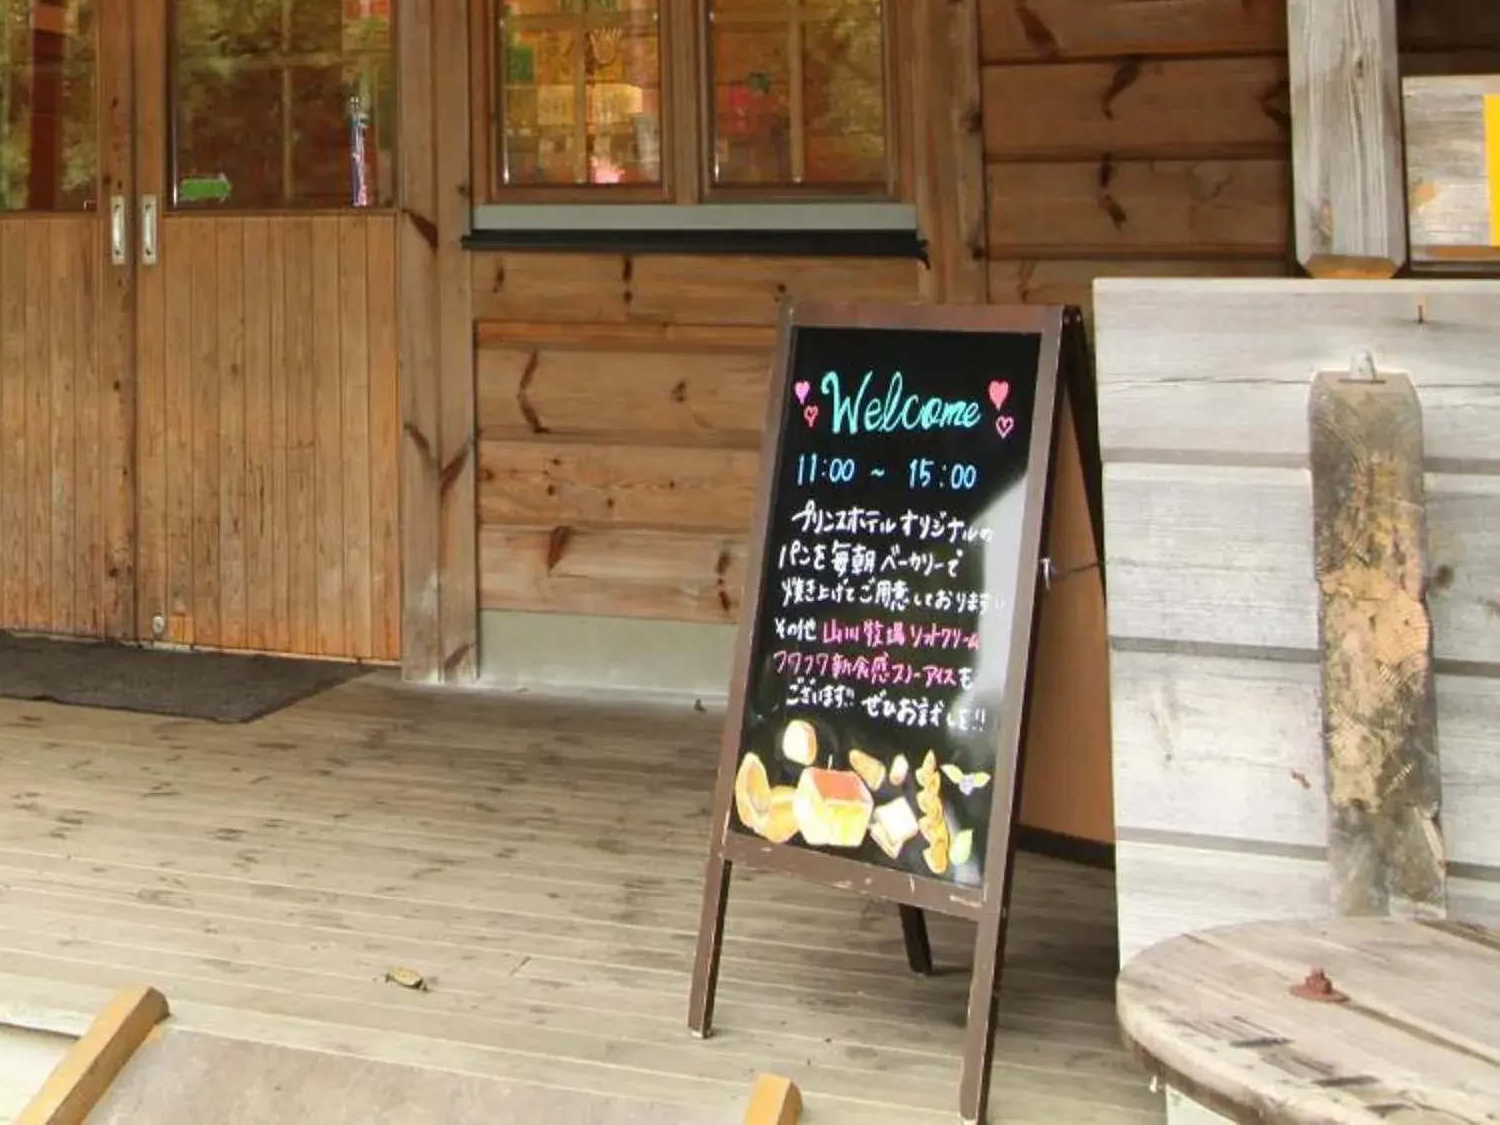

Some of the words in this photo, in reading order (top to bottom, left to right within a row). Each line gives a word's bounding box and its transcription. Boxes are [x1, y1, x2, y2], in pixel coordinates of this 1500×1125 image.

[820, 370, 982, 435] Welcome
[797, 452, 855, 486] 11:00
[909, 457, 977, 490] 15:00
